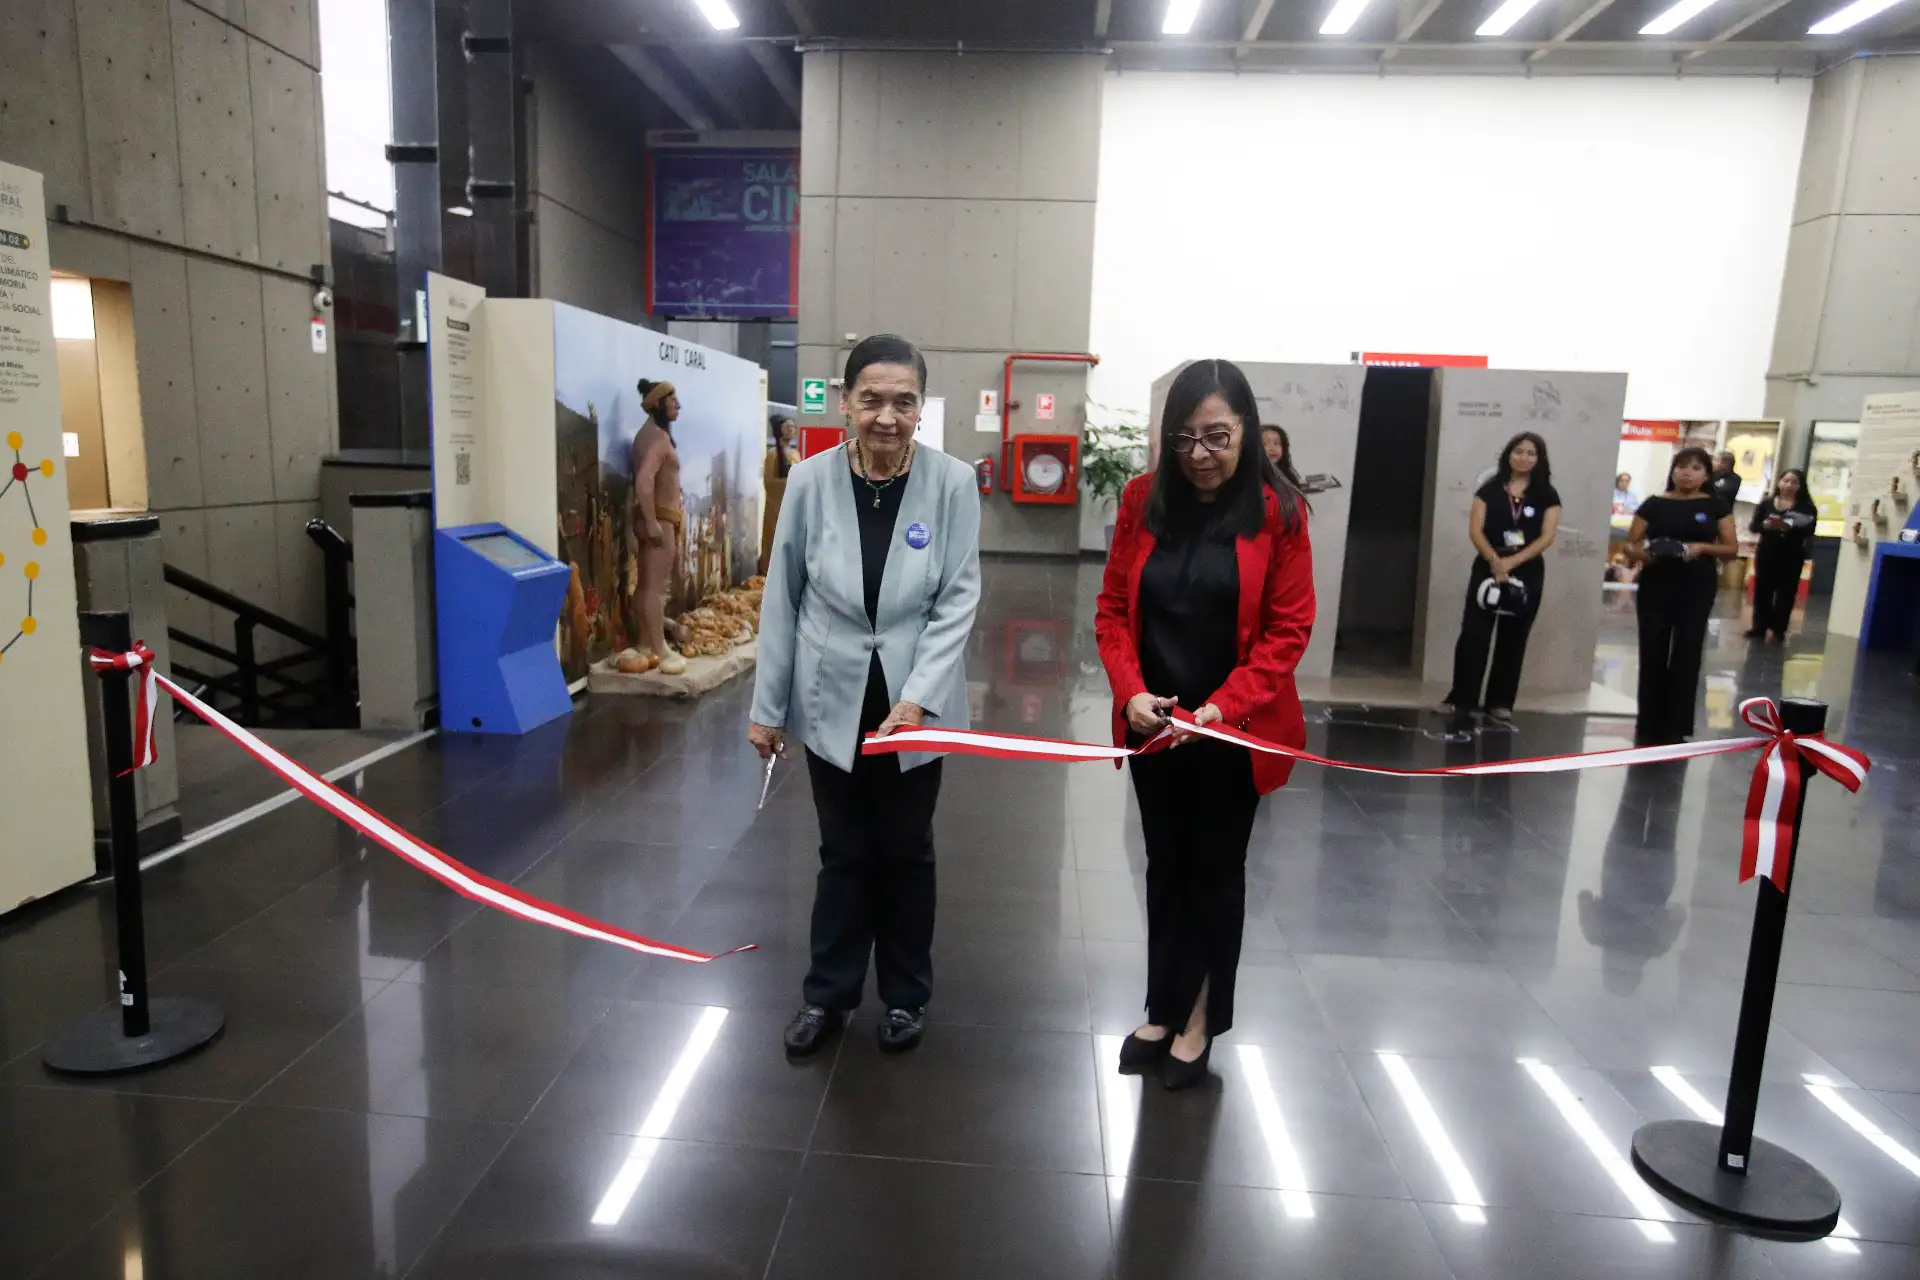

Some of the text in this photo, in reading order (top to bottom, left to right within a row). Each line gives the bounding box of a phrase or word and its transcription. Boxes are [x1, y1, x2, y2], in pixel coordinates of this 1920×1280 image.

[743, 163, 799, 183] SALA
[0, 192, 23, 208] RAL
[8, 234, 20, 246] 02
[12, 303, 42, 316] SOCIAL
